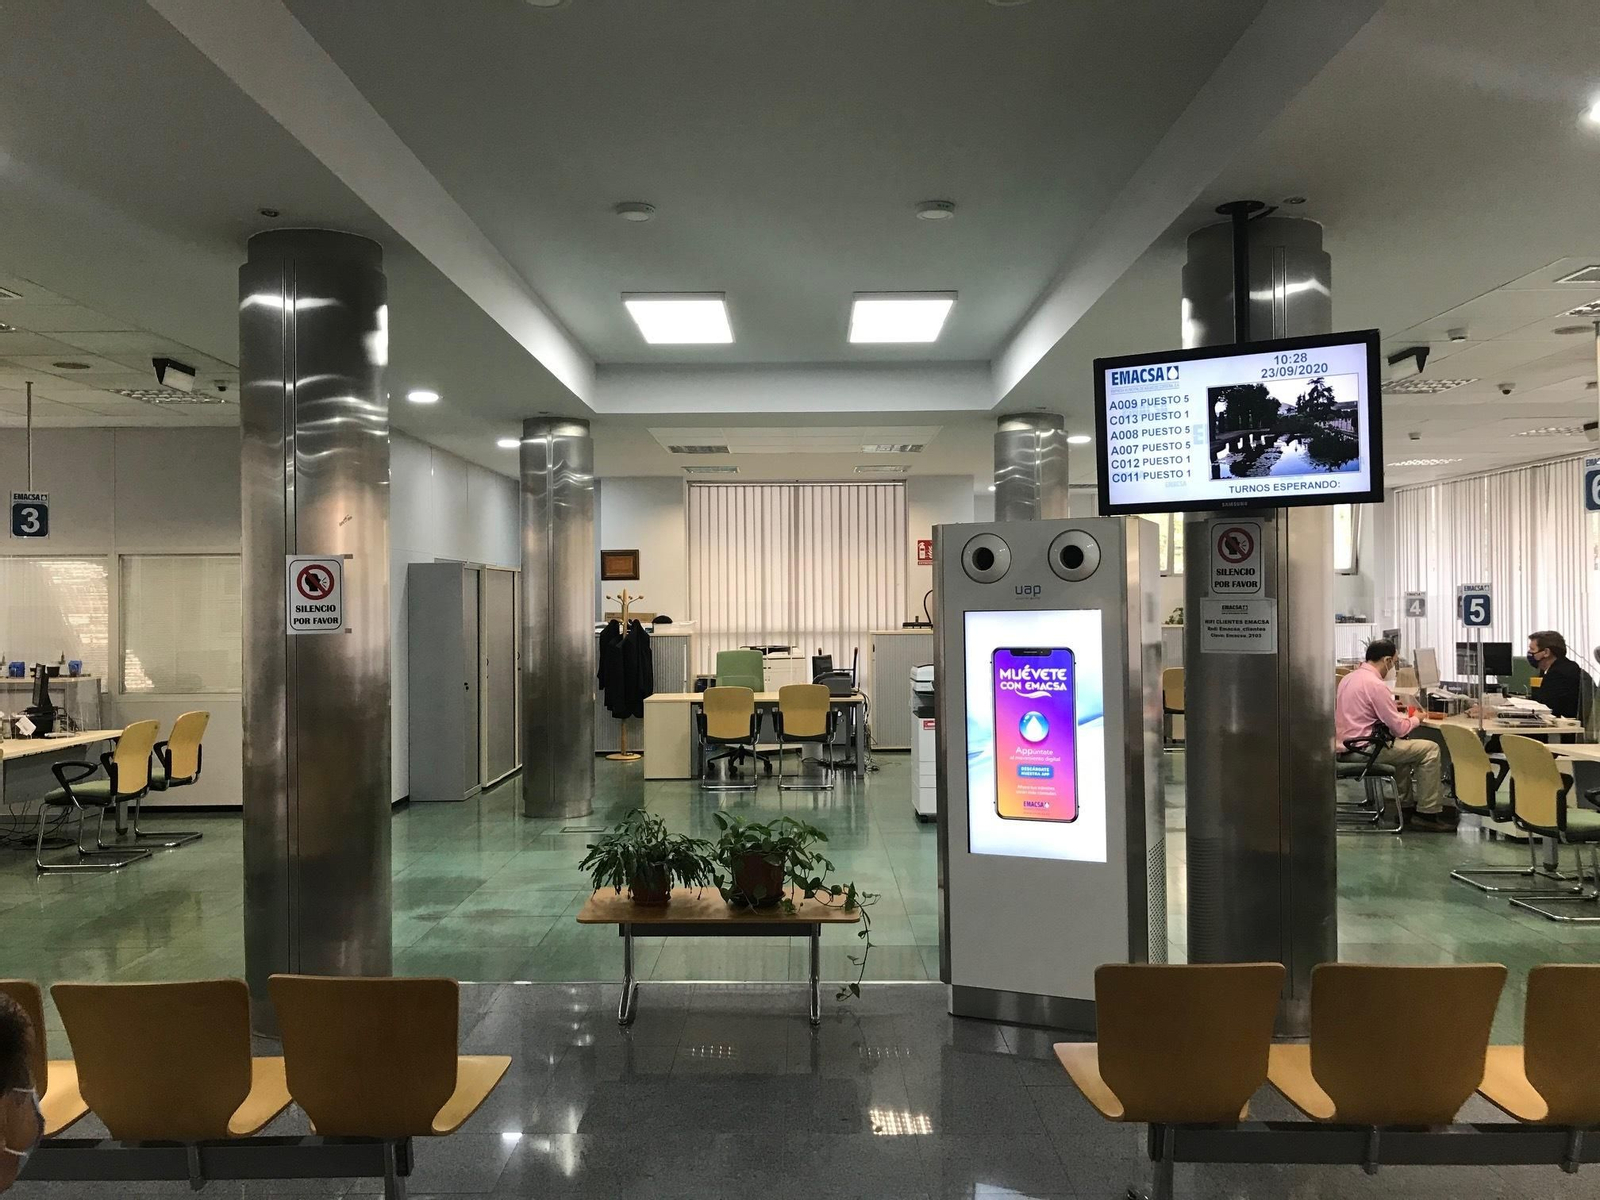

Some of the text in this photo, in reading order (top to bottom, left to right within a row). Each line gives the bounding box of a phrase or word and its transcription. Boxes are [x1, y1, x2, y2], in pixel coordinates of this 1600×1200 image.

[1274, 352, 1308, 365] 10:28
[1111, 367, 1165, 386] EMACSA
[1261, 362, 1328, 378] 23/09/2020
[1109, 394, 1190, 411] A009 PUESTO 5
[1109, 410, 1190, 426] C013 PUESTO 1
[1110, 429, 1139, 441] A008
[1141, 426, 1182, 437] PUESTO
[1184, 426, 1191, 434] 5
[1110, 441, 1192, 456] A007 PUESTO 5
[1111, 455, 1191, 470] C012 PUESTO 1
[1112, 470, 1191, 483] C011 PUESTO 1
[1229, 480, 1340, 494] TURNOS ESPERANDO:
[20, 508, 40, 533] 3
[1216, 568, 1256, 576] SILENCIO
[1015, 584, 1042, 598] uap
[296, 604, 336, 612] SILENCIO
[1409, 600, 1422, 615] 4
[1470, 598, 1486, 623] 5
[1000, 664, 1067, 680] MUÉVETE
[1000, 681, 1068, 691] CON EMACSA
